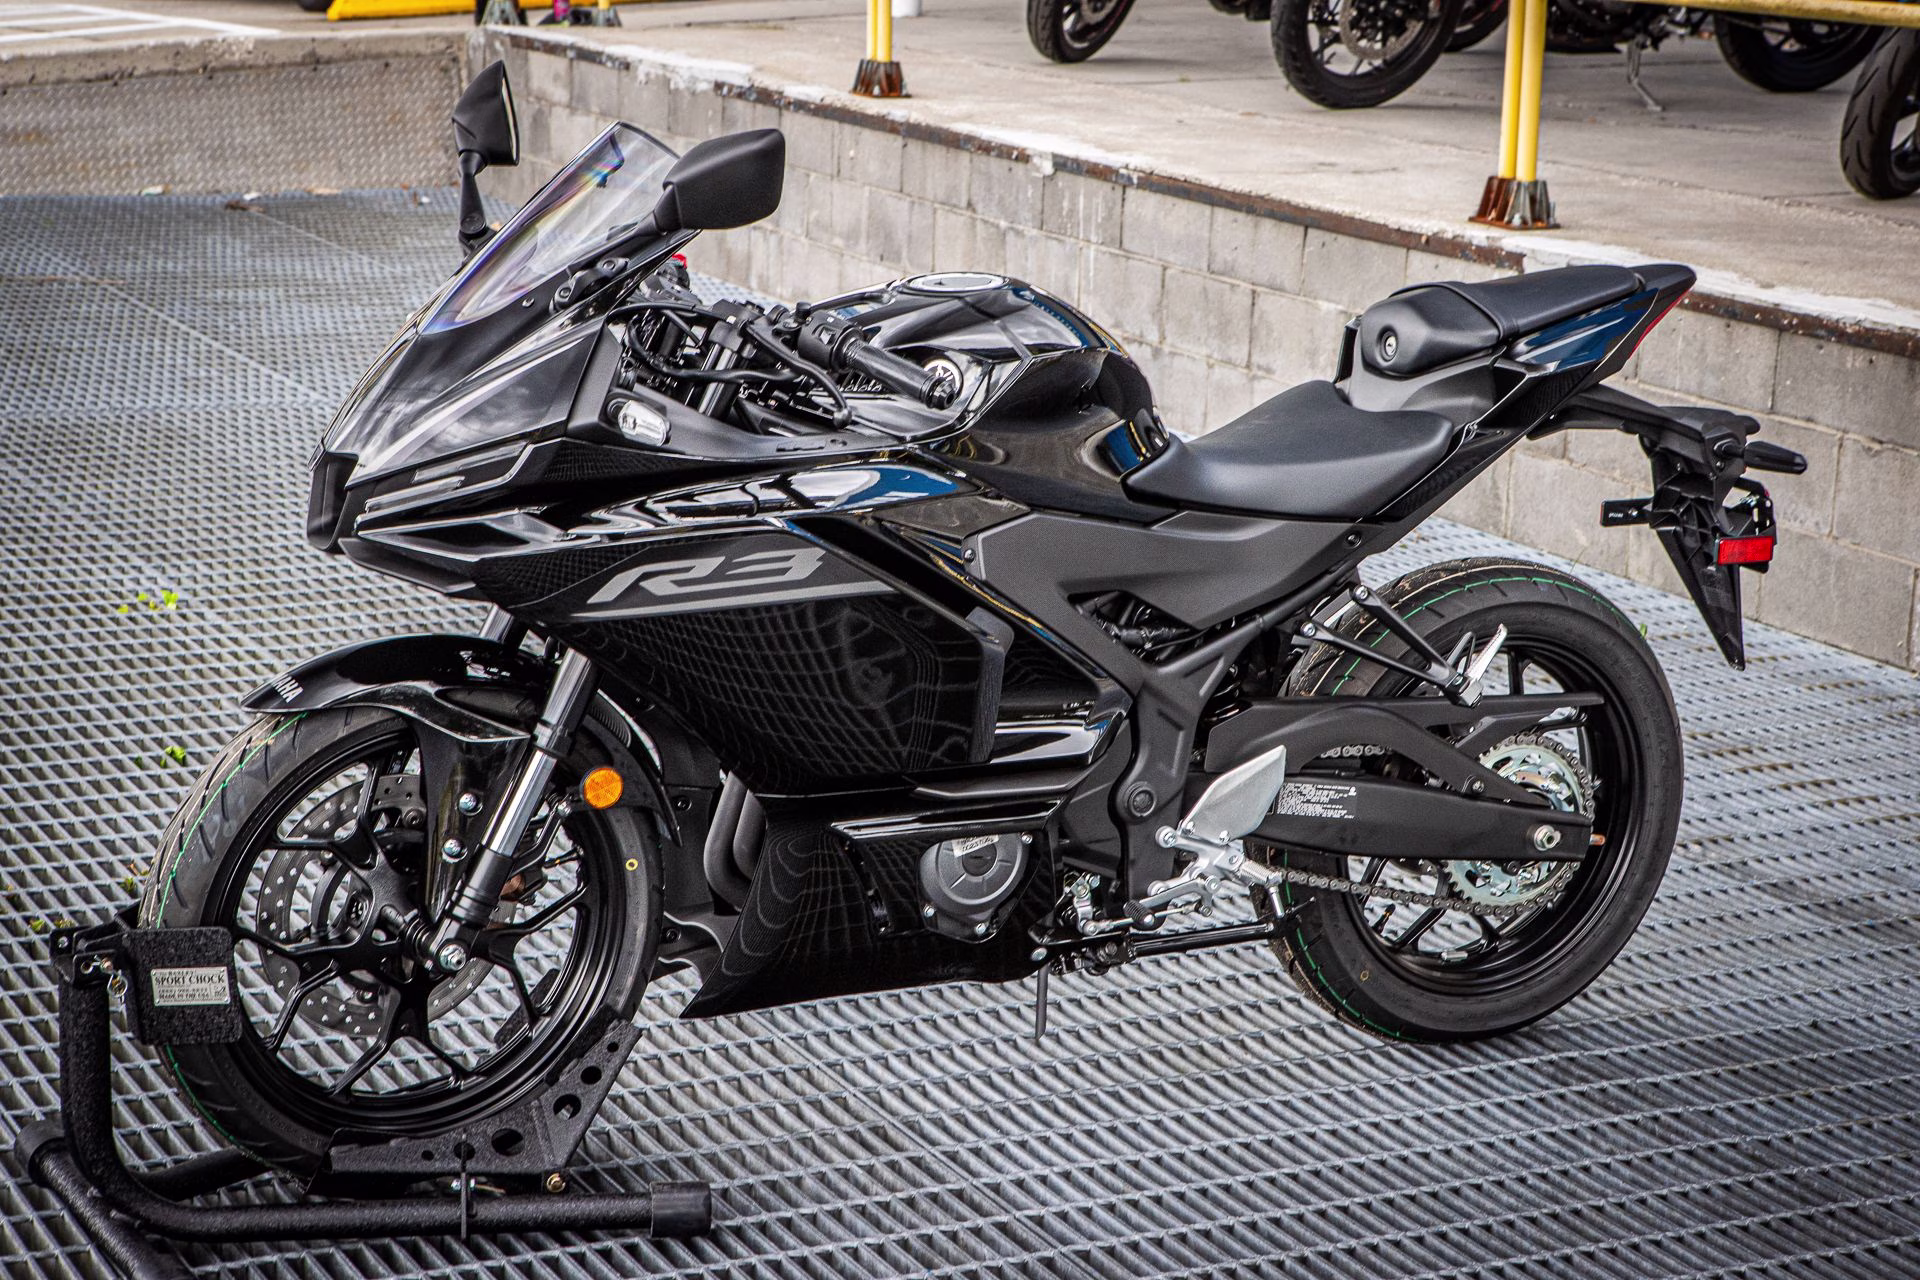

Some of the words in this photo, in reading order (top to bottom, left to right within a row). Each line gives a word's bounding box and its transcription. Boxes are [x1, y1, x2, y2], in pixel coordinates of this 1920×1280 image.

[587, 548, 827, 604] R3
[155, 976, 185, 985] SPORT
[189, 974, 225, 984] CHOCK
